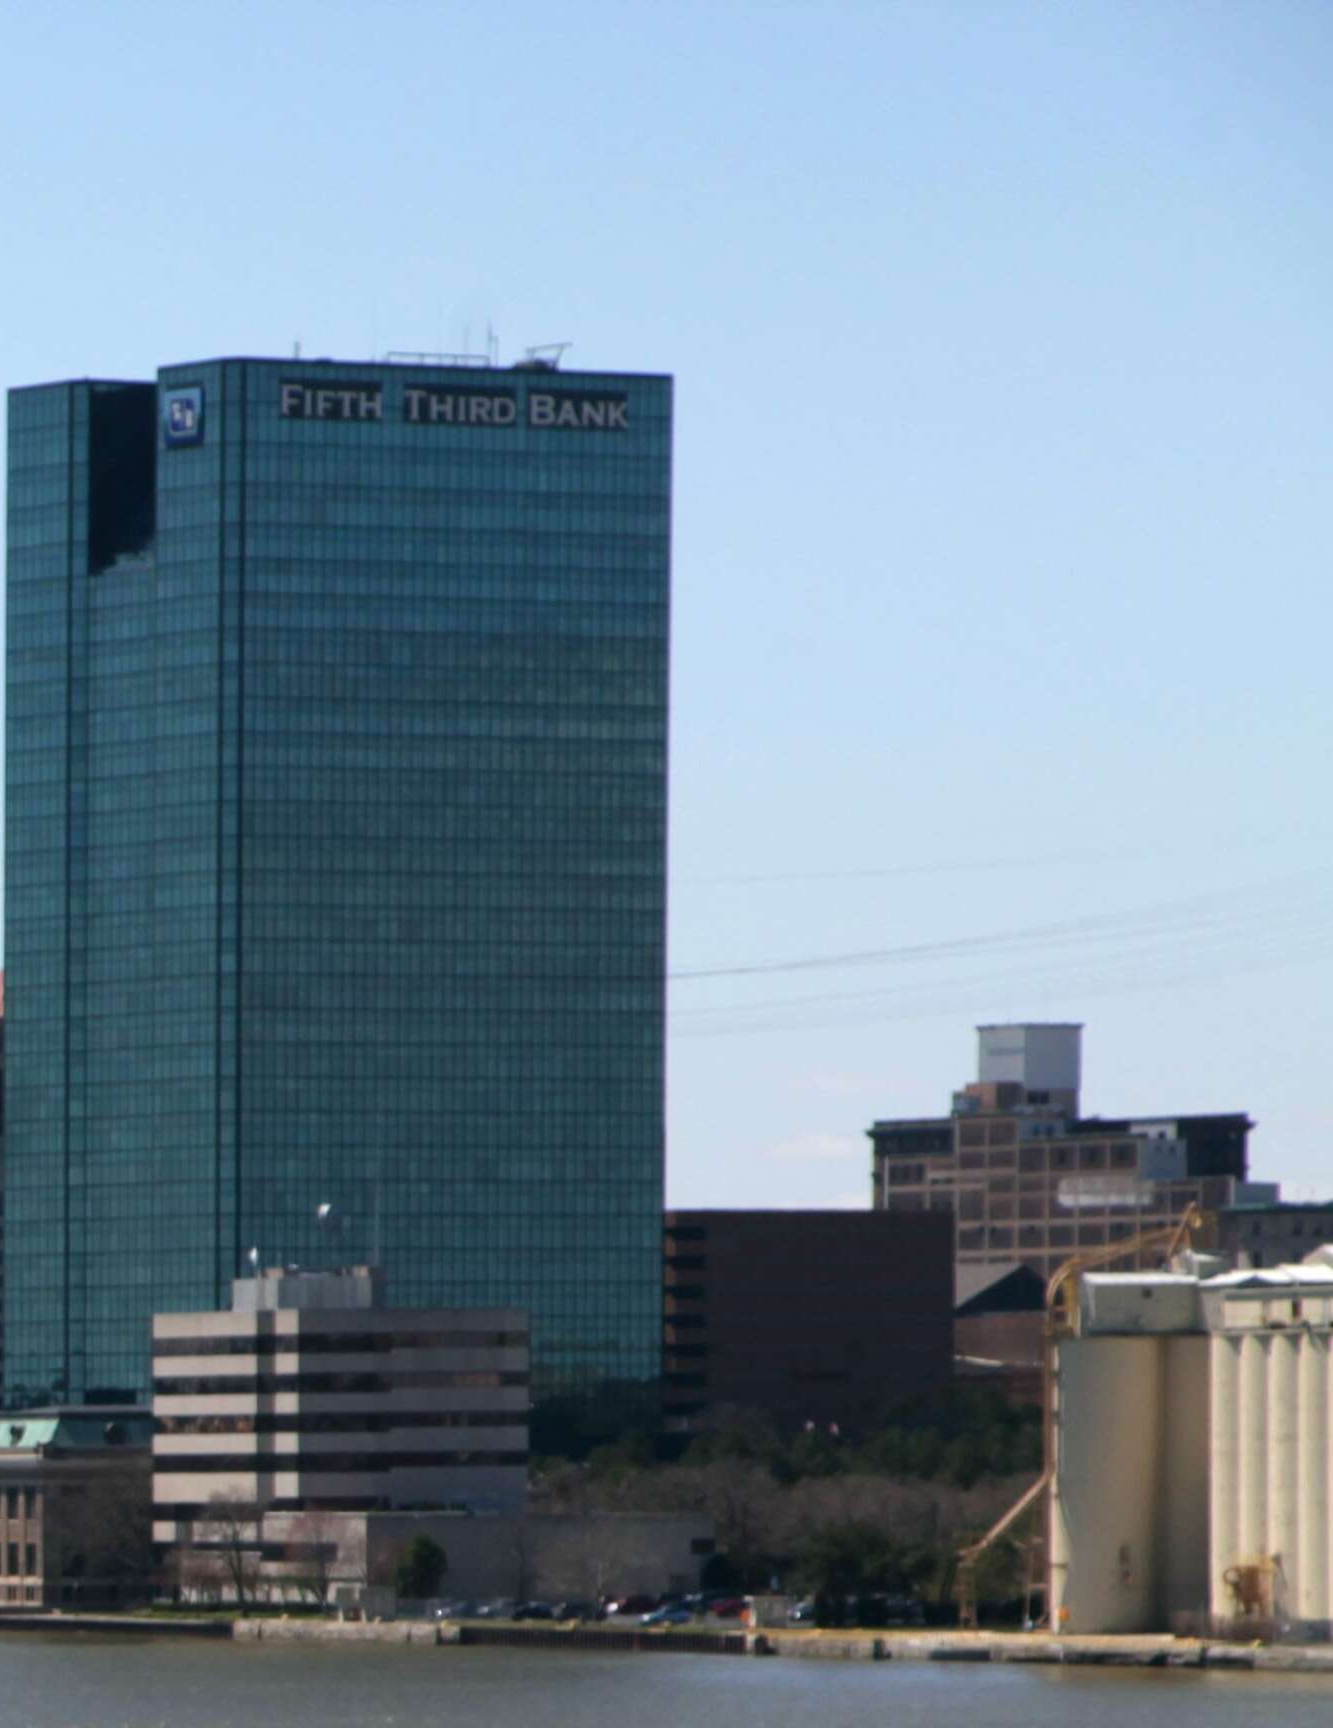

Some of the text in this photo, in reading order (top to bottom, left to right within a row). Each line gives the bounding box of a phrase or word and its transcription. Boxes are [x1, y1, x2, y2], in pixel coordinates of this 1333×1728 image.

[282, 384, 629, 428] FIFTH THIRD BANK
